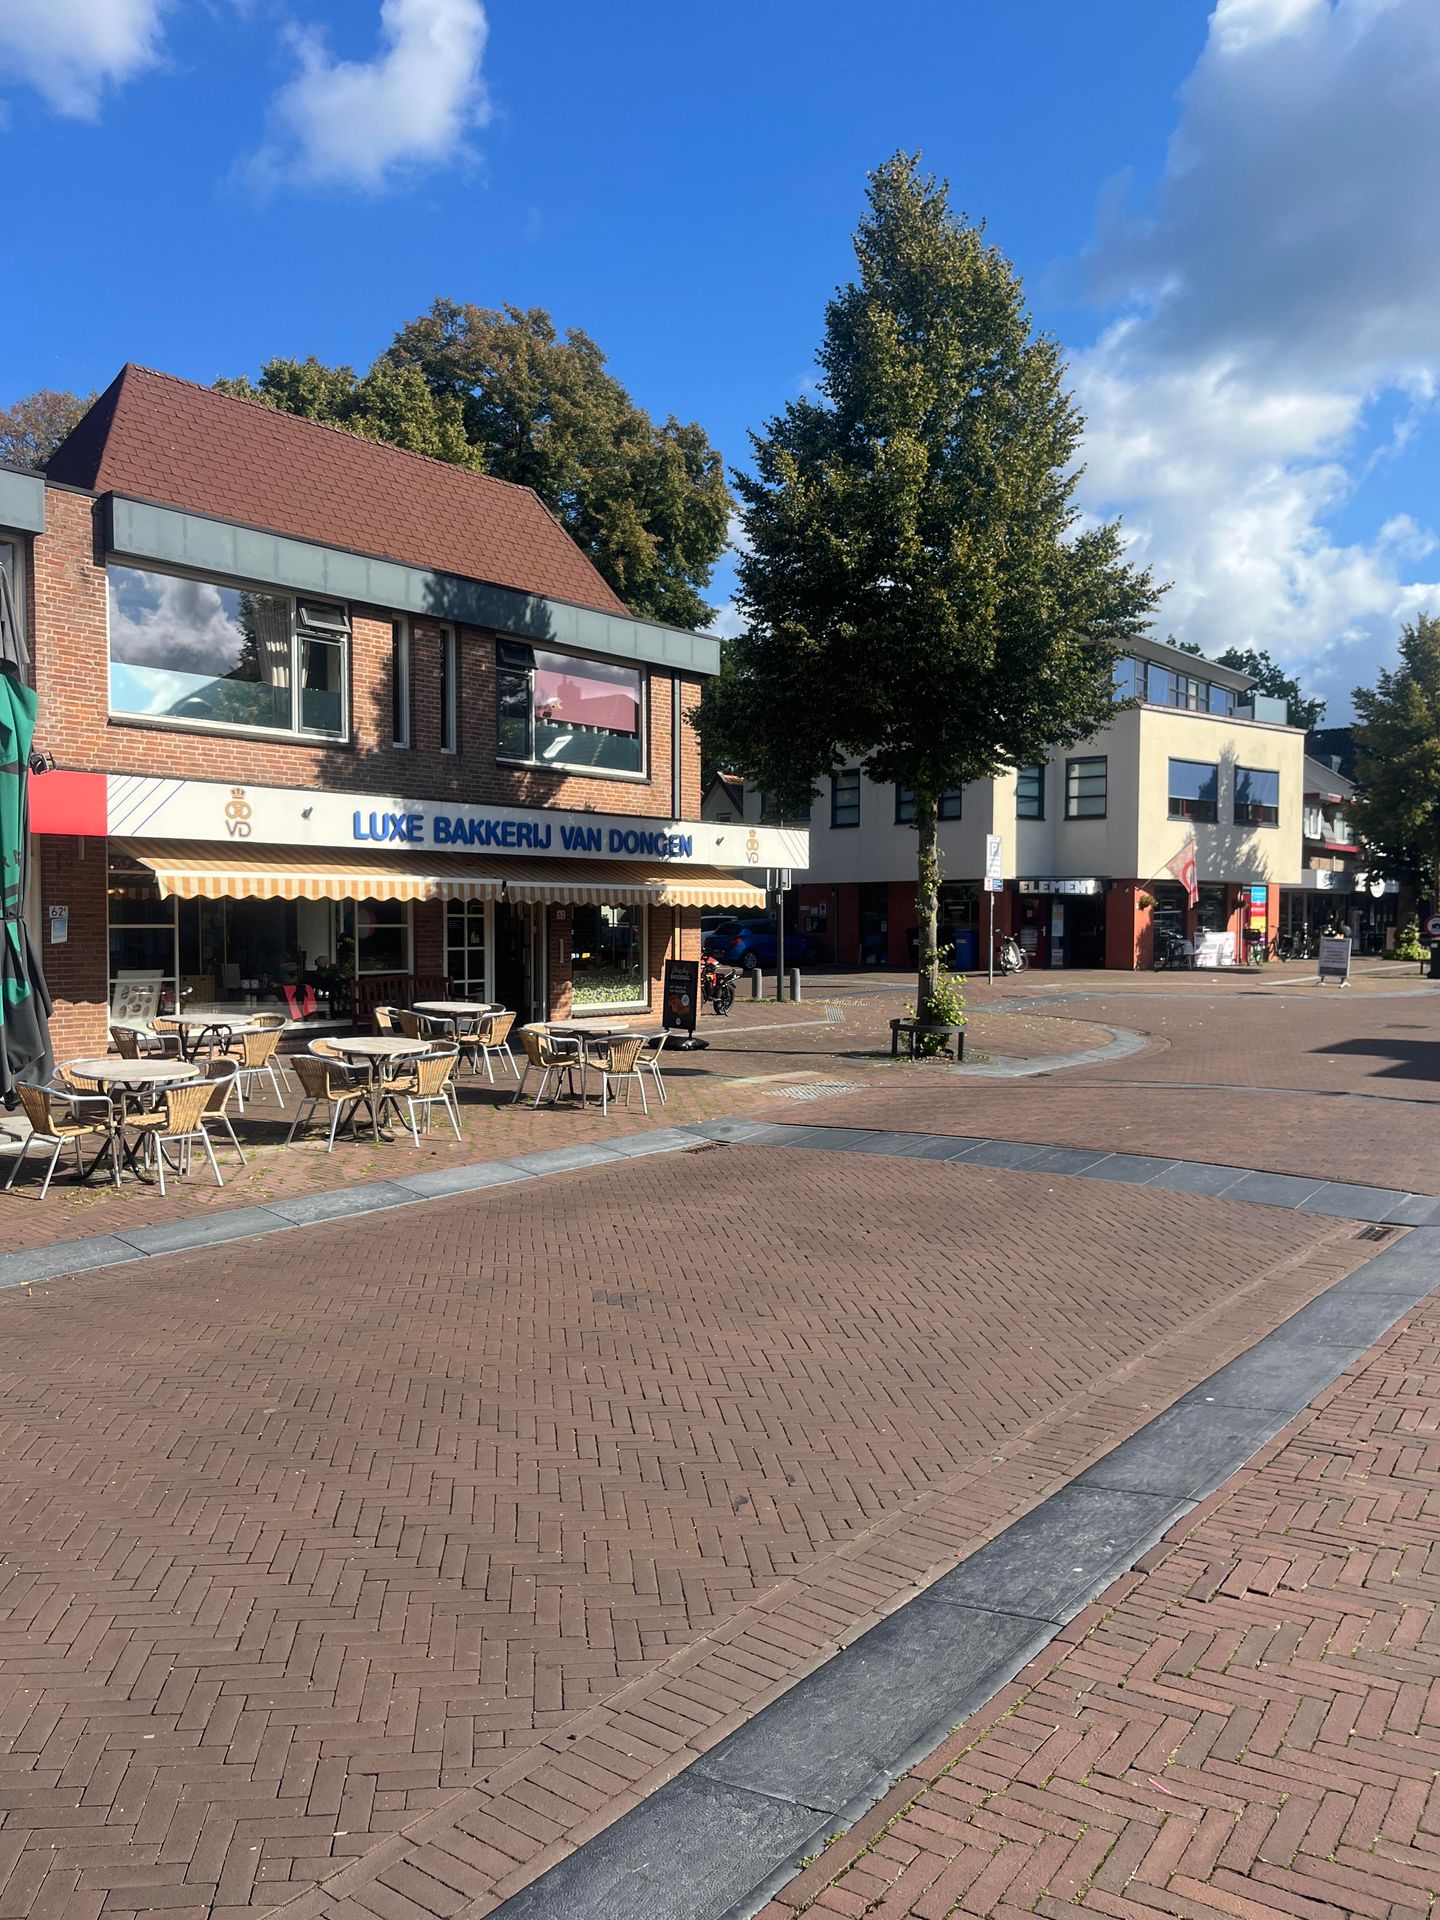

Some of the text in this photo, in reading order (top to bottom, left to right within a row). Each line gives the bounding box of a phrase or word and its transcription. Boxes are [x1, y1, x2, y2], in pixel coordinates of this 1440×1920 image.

[225, 820, 251, 837] VD
[353, 810, 693, 858] LUXE BAKKERIJ VAN DONGEN
[746, 851, 759, 864] VD
